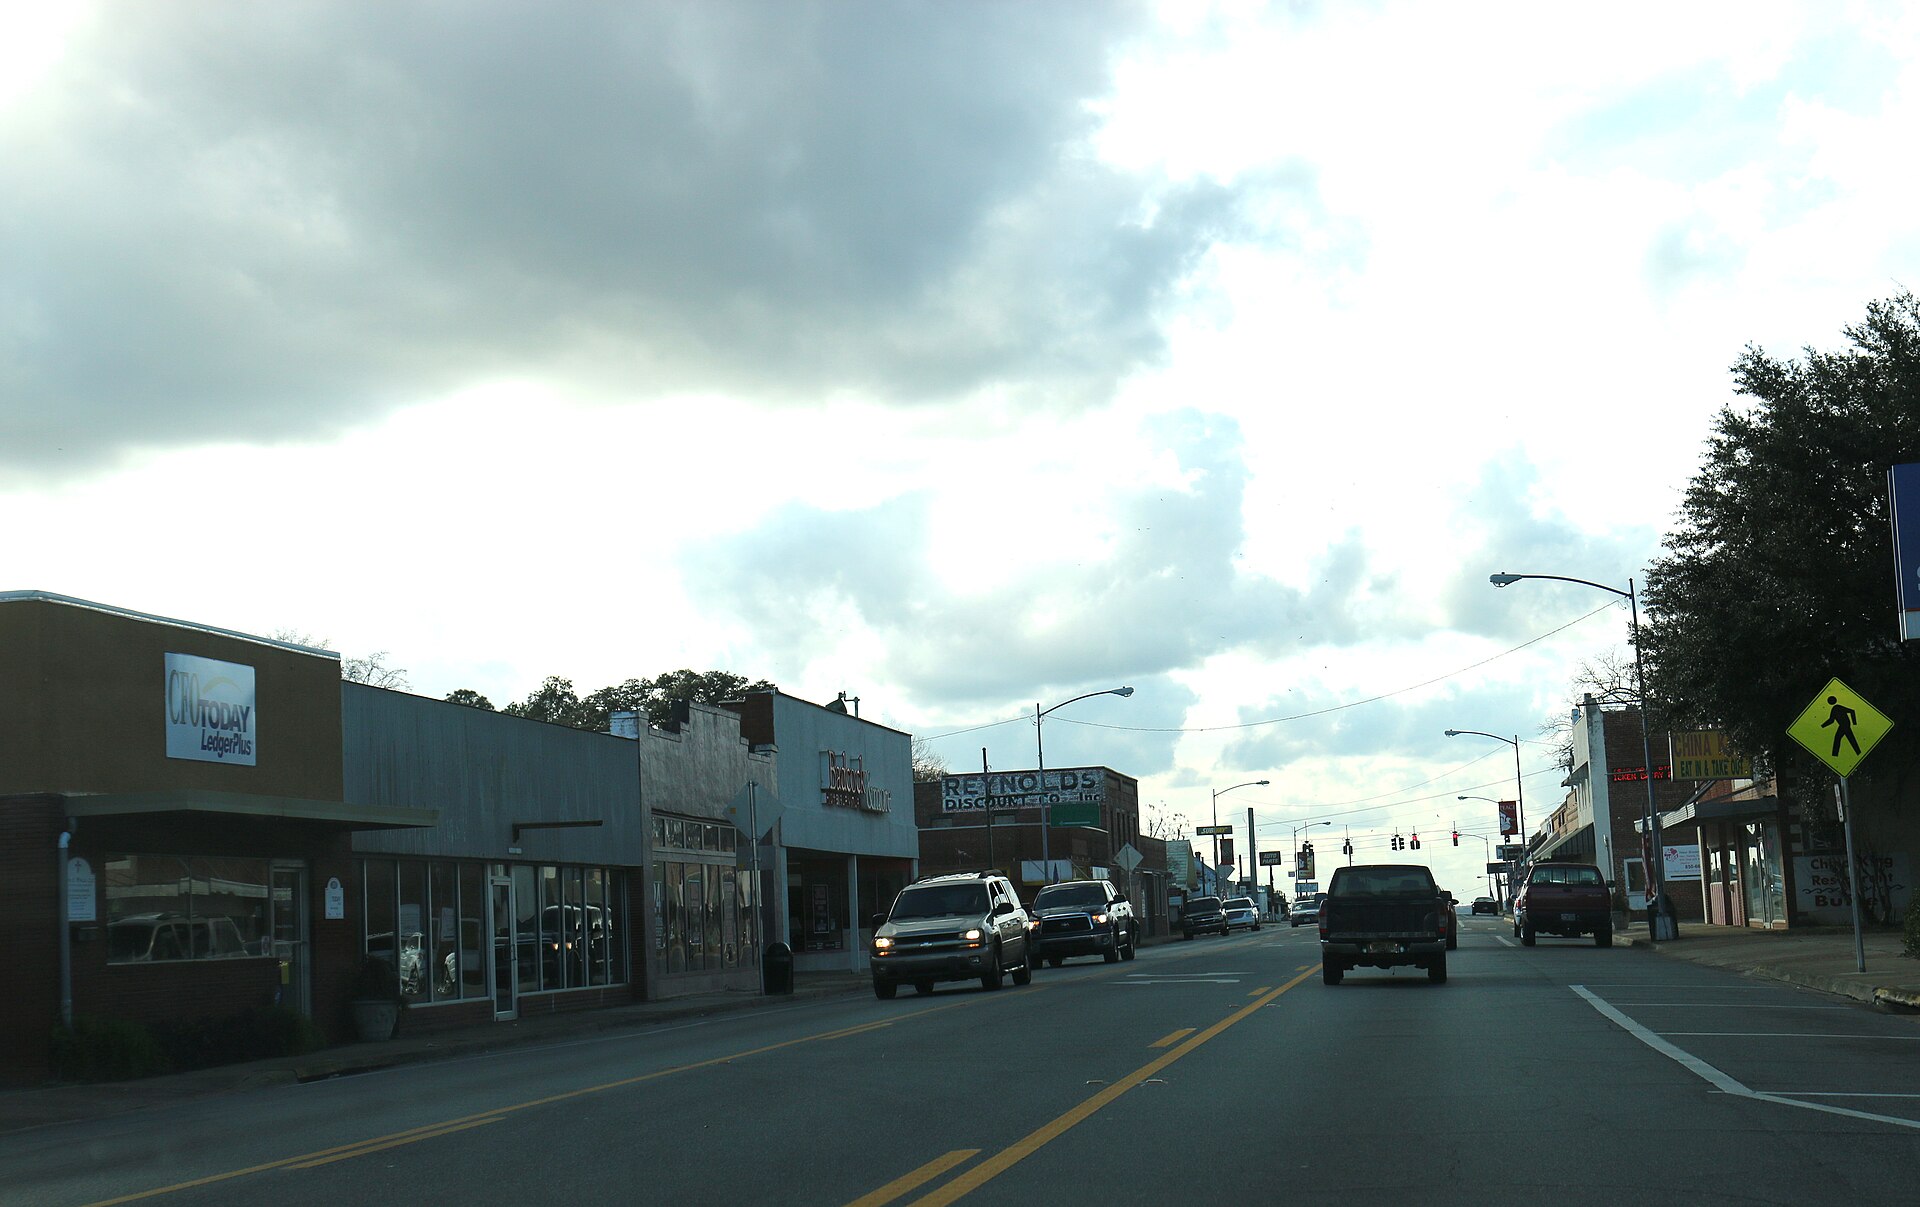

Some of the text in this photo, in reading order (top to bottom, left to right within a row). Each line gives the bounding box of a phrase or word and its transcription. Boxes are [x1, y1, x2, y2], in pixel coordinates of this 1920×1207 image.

[199, 699, 250, 733] TODAY
[201, 728, 252, 758] LedgerPlus
[1674, 732, 1712, 757] CHINA
[1680, 760, 1692, 777] EAT
[1695, 760, 1702, 777] IN
[1704, 760, 1709, 776] &
[1711, 759, 1729, 776] TAKE
[945, 771, 1097, 797] REYNOLDS
